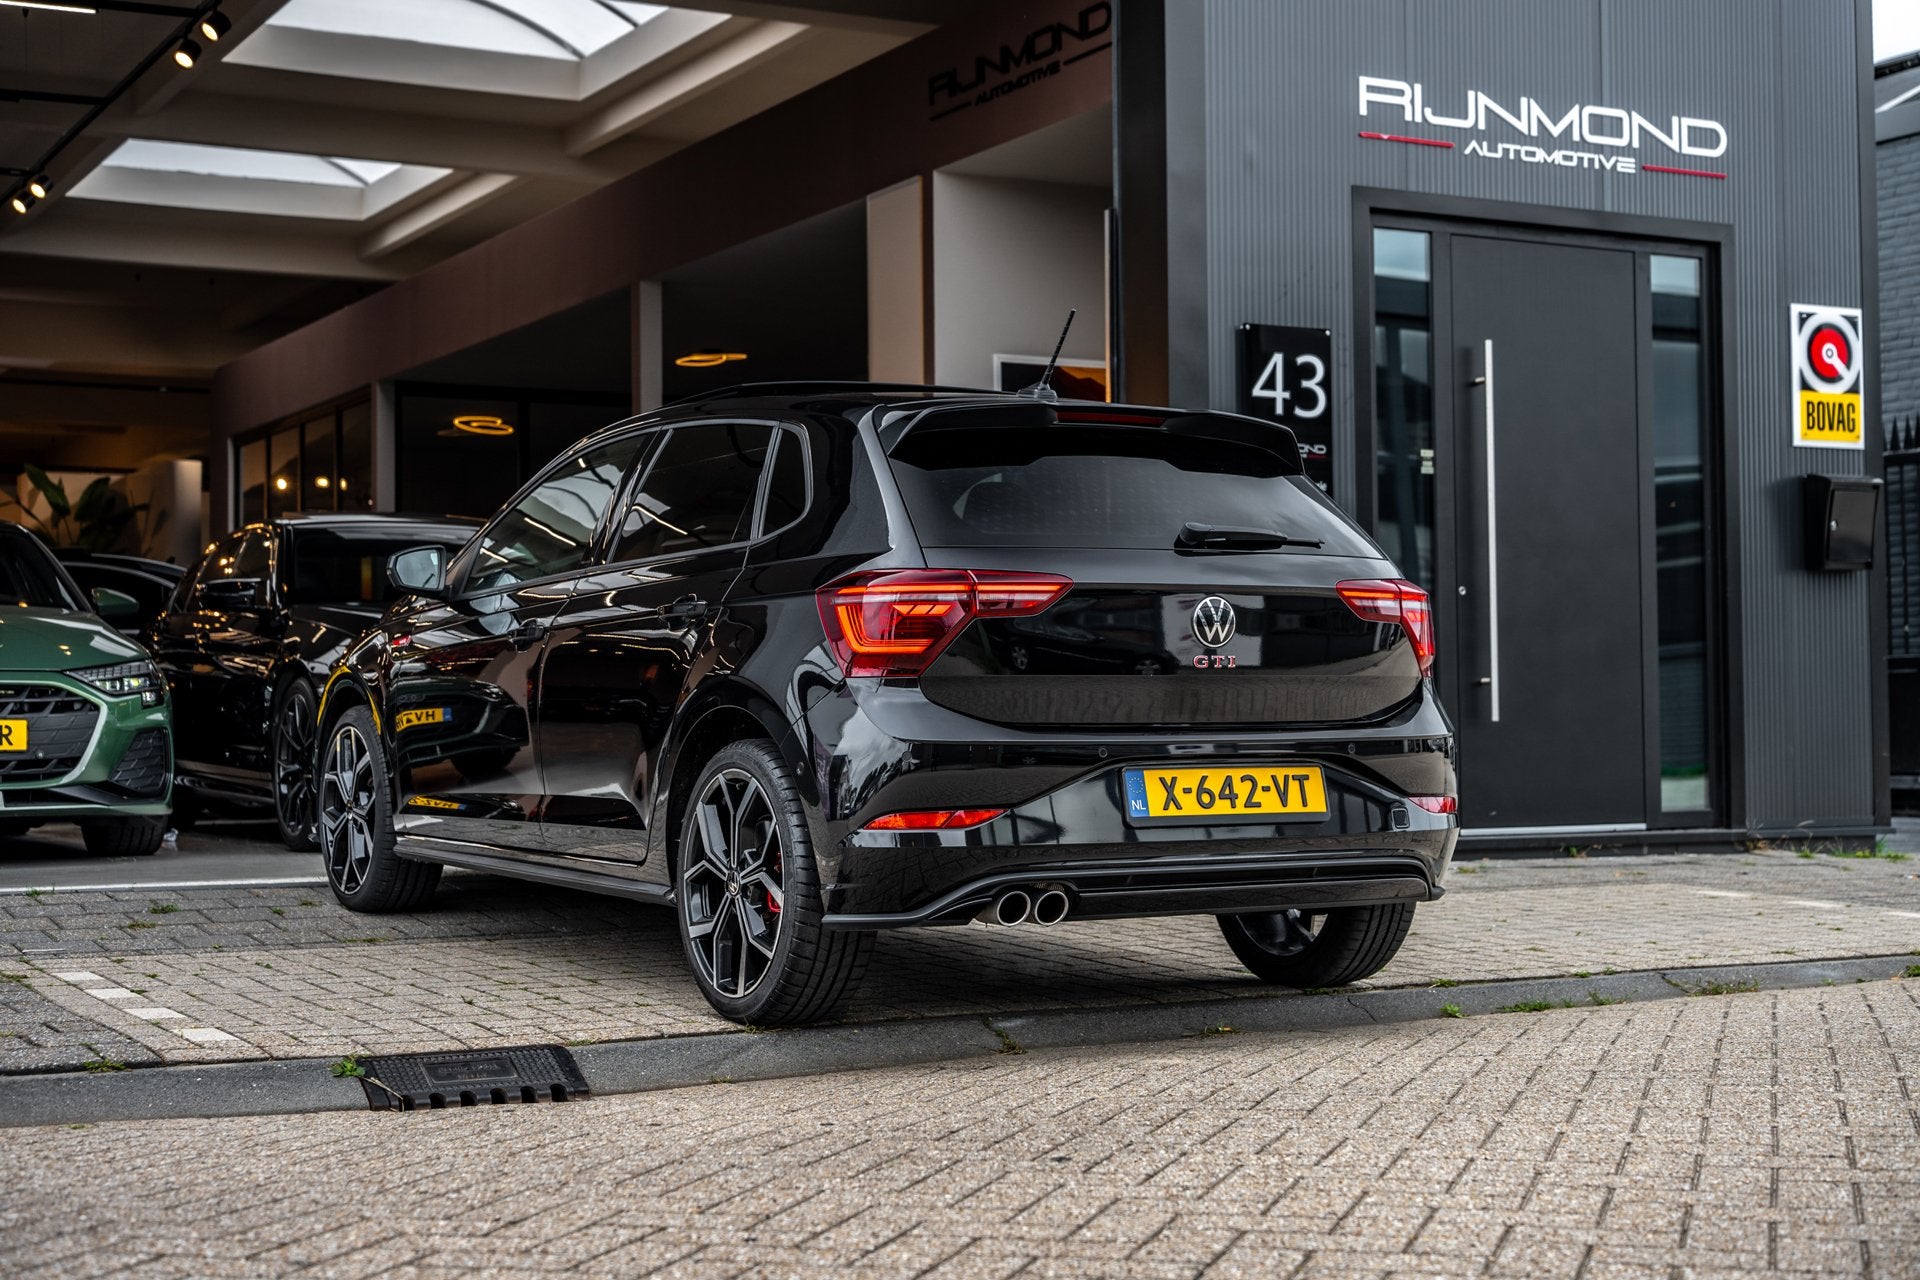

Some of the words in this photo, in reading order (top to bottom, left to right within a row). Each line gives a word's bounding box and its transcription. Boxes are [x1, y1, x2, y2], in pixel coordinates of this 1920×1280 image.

[974, 60, 1062, 106] AUTOMOTIVE
[1359, 75, 1728, 158] RIJNMOND
[1464, 139, 1636, 173] AUTOMOTIVE
[1251, 351, 1328, 419] 43
[1806, 400, 1857, 432] BOVAG
[1193, 654, 1236, 668] GTI
[1131, 799, 1147, 810] NL
[1158, 774, 1310, 812] X-642-VT
